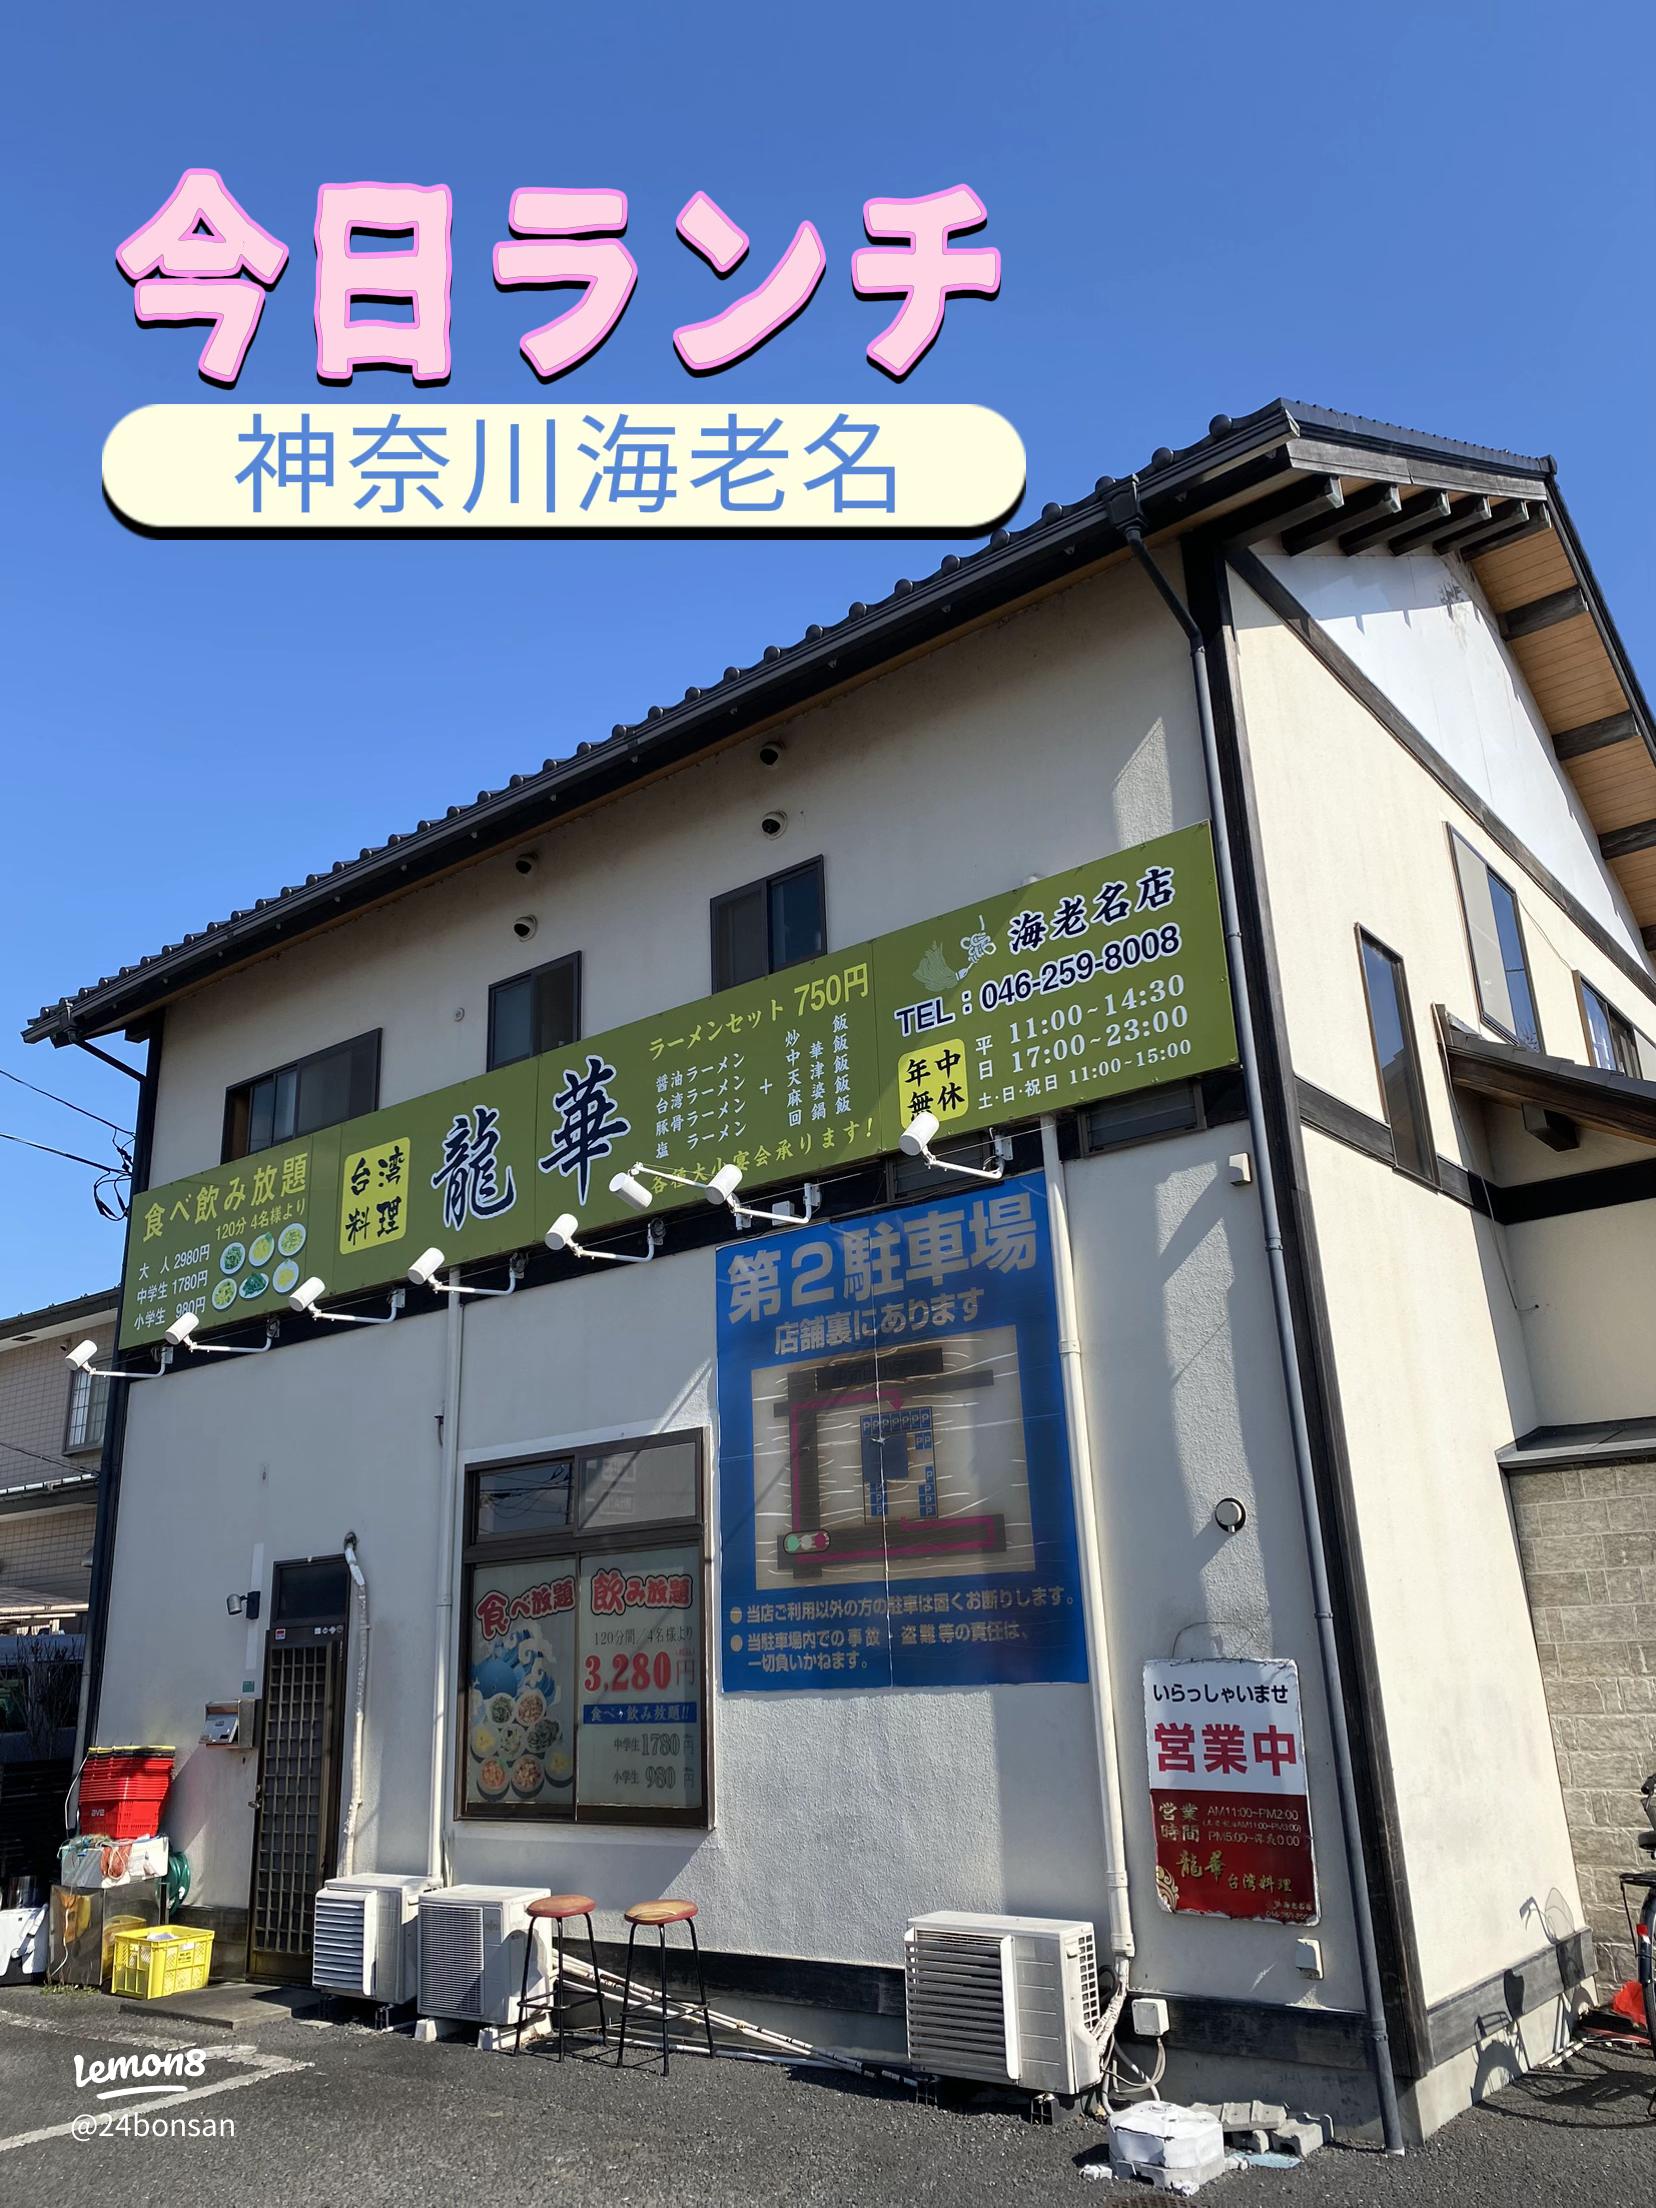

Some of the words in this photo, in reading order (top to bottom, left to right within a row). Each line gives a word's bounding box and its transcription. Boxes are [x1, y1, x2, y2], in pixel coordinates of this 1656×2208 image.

[1008, 866, 1175, 954] 海老名店
[980, 923, 1181, 1012] 046-259-8008
[649, 999, 784, 1061] ラーメンセット
[794, 963, 868, 1017] 750円
[655, 1075, 746, 1115] 台湾ラーメン
[655, 1098, 747, 1136] 豚骨ラーメン
[143, 1152, 308, 1243] 食べ飲み放題
[173, 1243, 210, 1270] 2980円
[727, 1191, 1038, 1325] 第2駐車場
[136, 1281, 168, 1304] 中学生
[171, 1269, 209, 1295] 1780円
[133, 1307, 166, 1331] 小学生
[775, 1287, 985, 1355] 店舗裏にあります
[476, 1575, 576, 1640] 食べ放題
[590, 1567, 693, 1616] 飲み放題
[1153, 1684, 1289, 1704] いらっしゃいませ
[1154, 1722, 1297, 1777] 営業中
